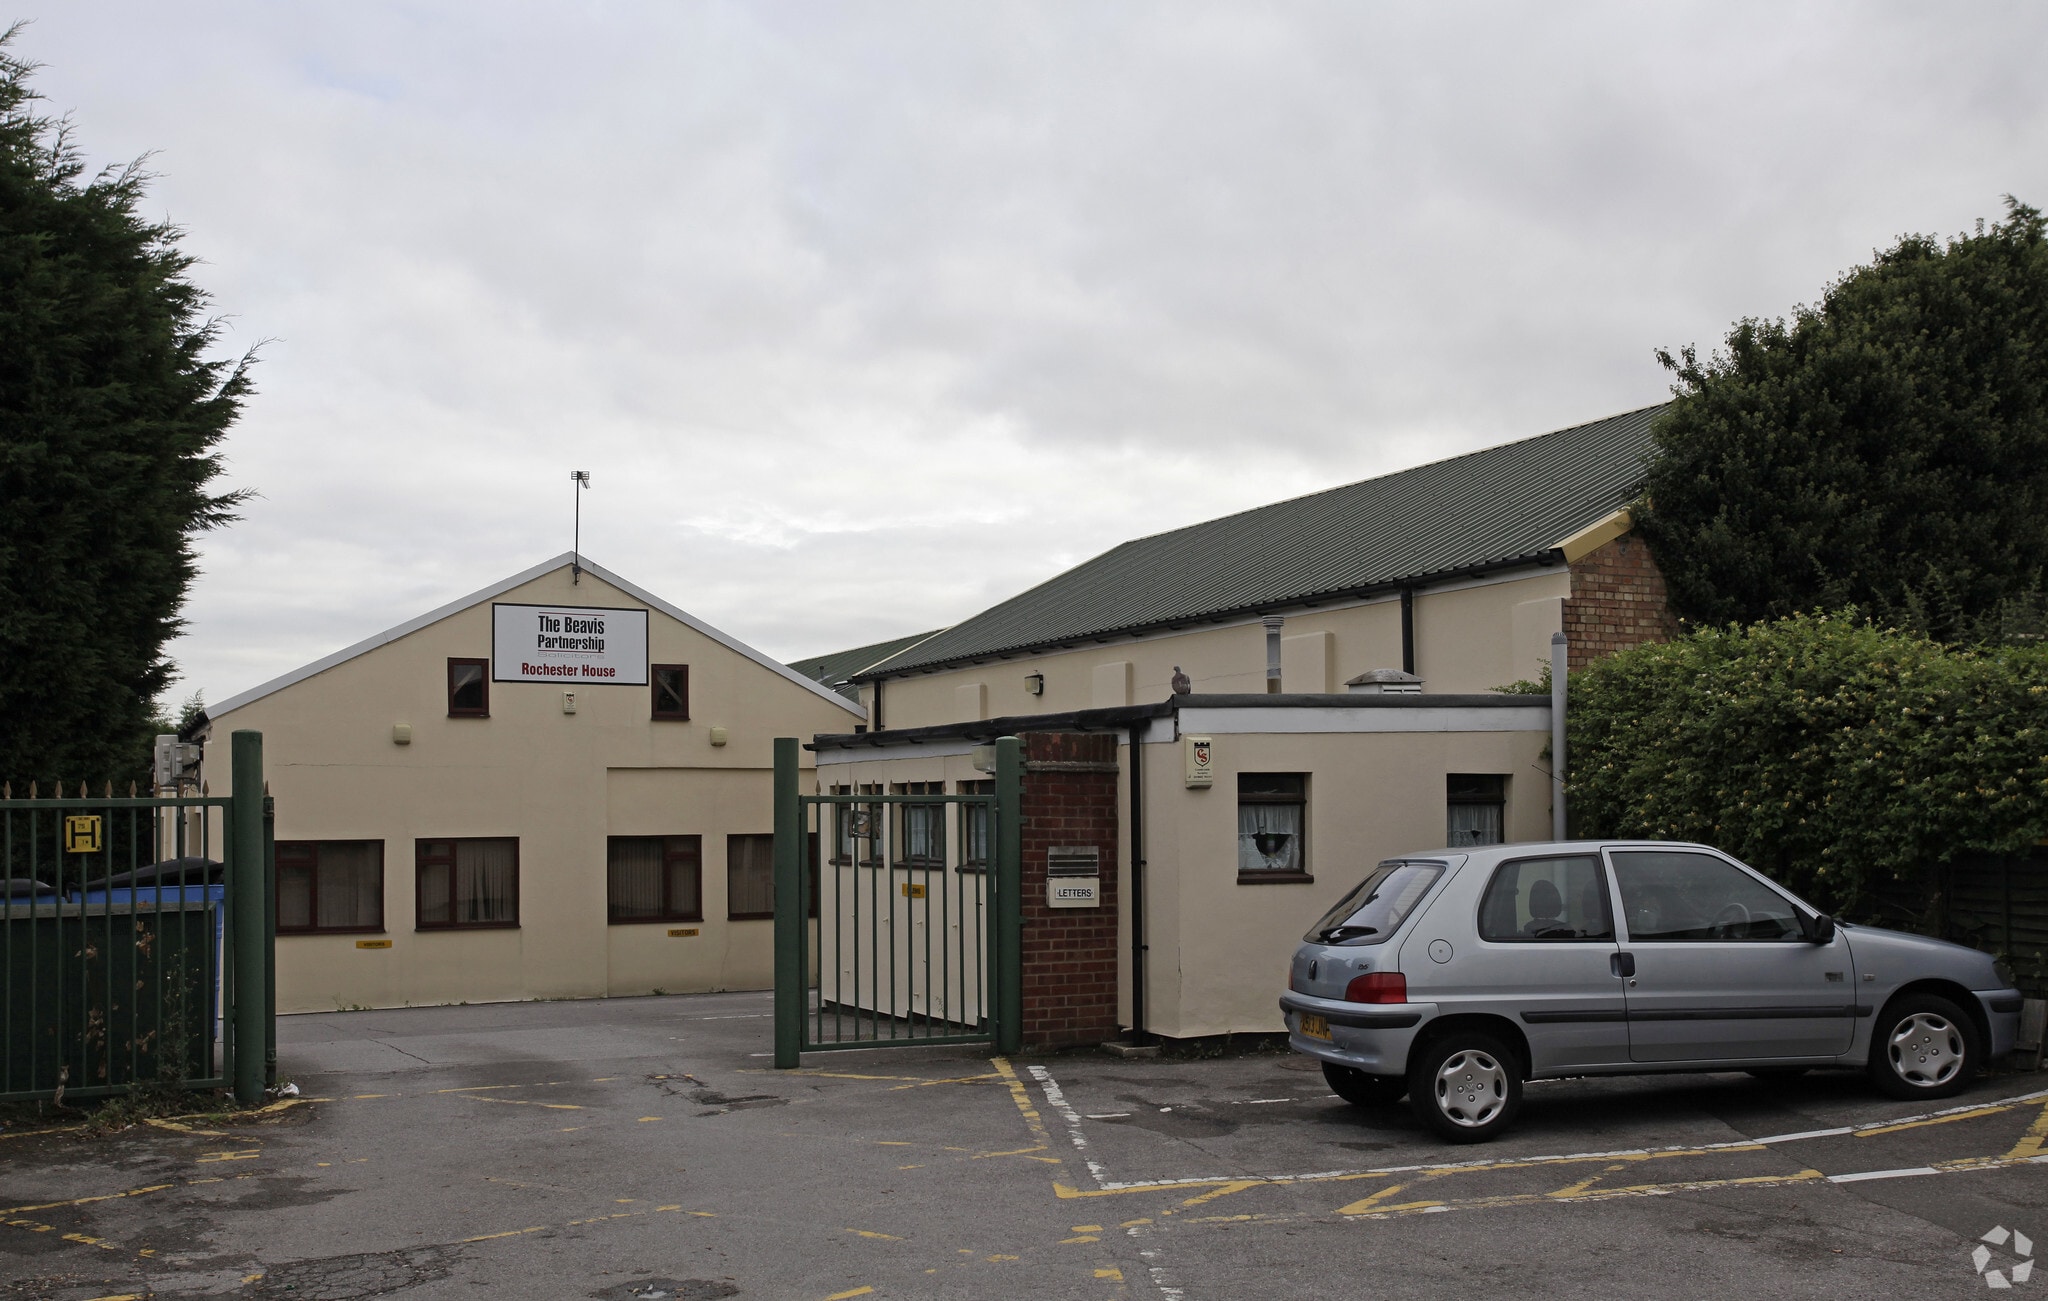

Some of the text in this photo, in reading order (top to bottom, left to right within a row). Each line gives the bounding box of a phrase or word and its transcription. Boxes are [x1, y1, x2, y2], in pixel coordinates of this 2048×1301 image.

[538, 615, 605, 634] The Beavis
[537, 634, 605, 652] Partnership
[521, 662, 616, 677] Rochester House
[71, 820, 96, 848] H
[1058, 888, 1092, 898] LETTERS
